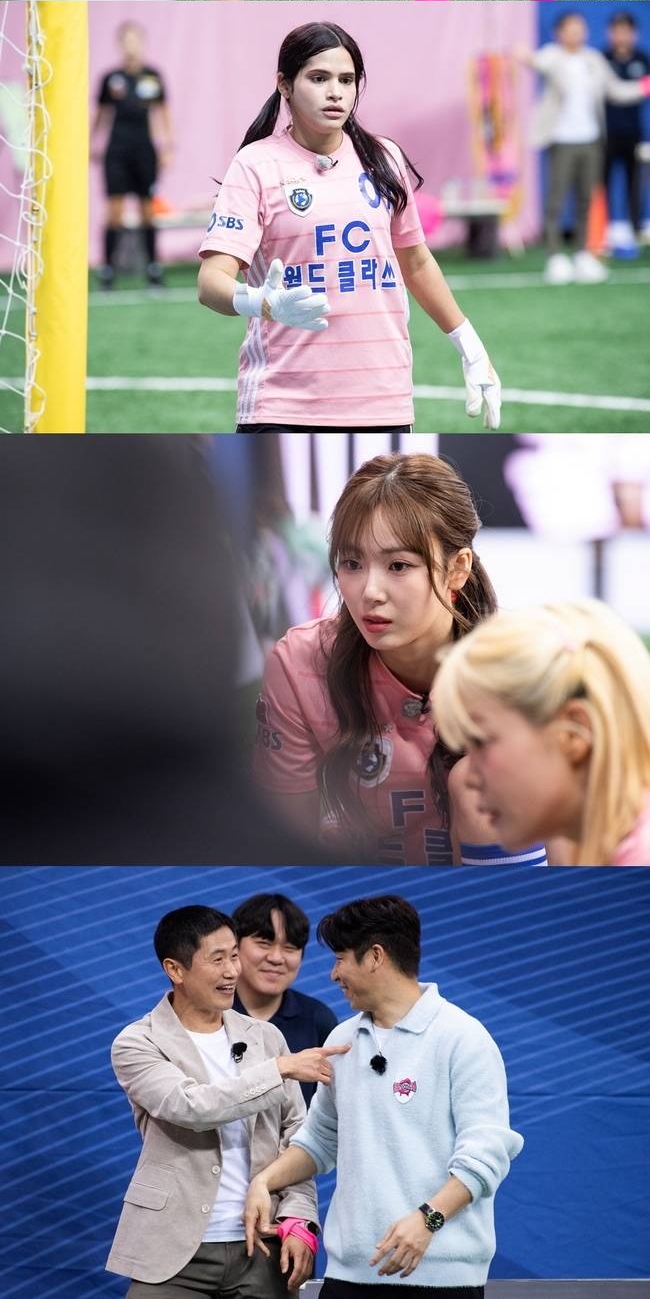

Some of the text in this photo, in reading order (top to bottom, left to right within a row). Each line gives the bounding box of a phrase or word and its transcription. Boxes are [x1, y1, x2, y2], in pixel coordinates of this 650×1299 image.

[217, 215, 244, 230] SBS
[316, 220, 370, 256] FC
[338, 258, 396, 293] 클라쓰
